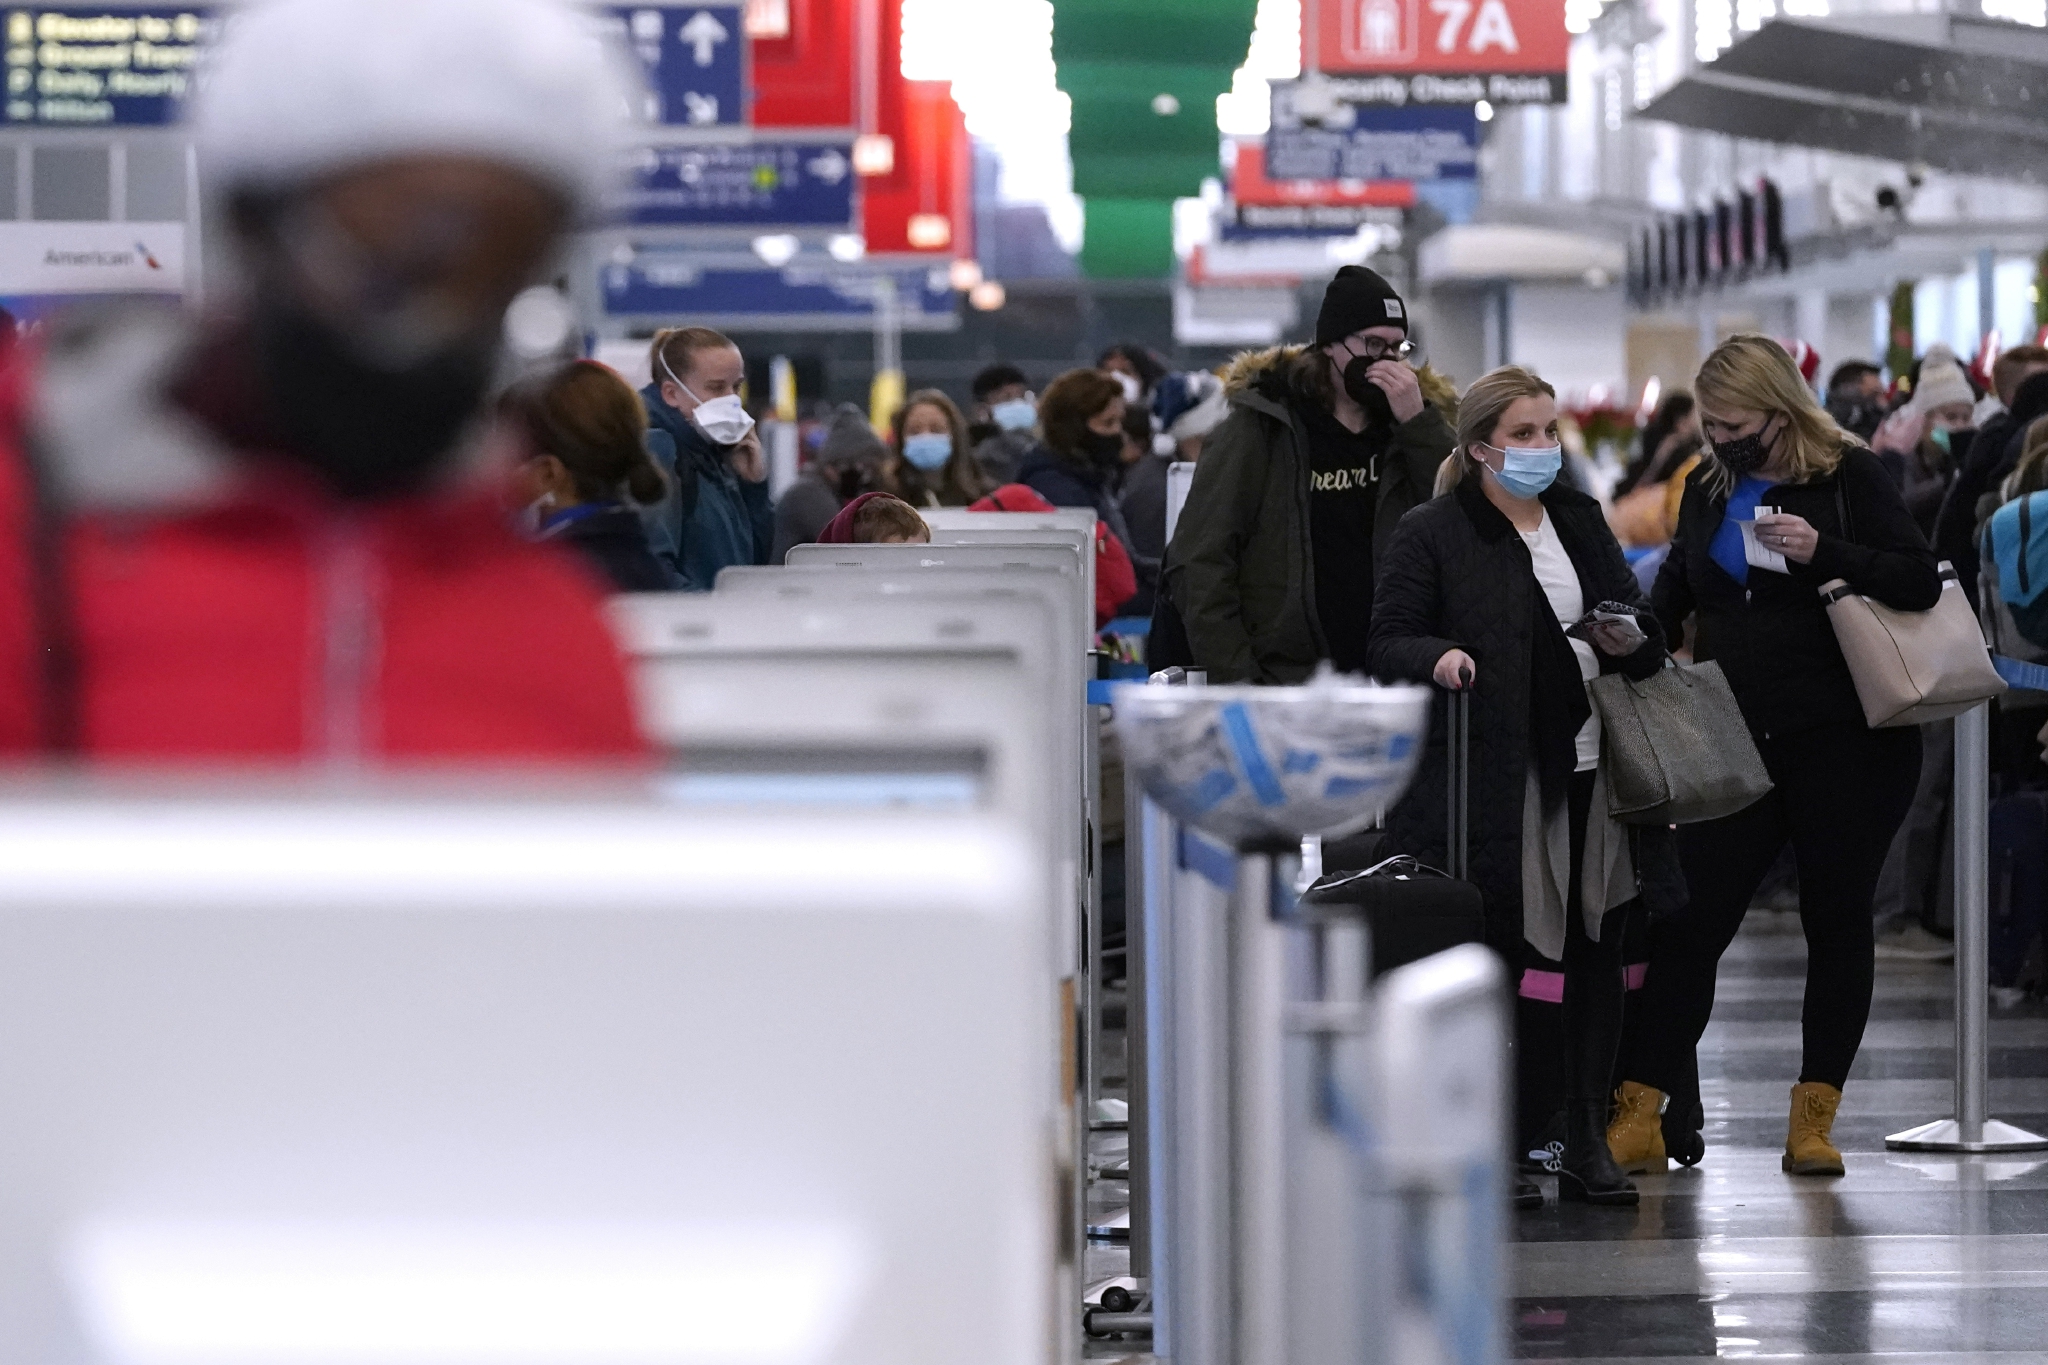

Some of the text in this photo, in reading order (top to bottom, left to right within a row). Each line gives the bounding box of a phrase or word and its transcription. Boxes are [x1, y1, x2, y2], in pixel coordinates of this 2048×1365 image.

[1429, 0, 1520, 54] 7A
[1411, 74, 1486, 102] Check
[1488, 74, 1551, 102] Point
[43, 248, 134, 266] American
[1310, 467, 1367, 492] ream
